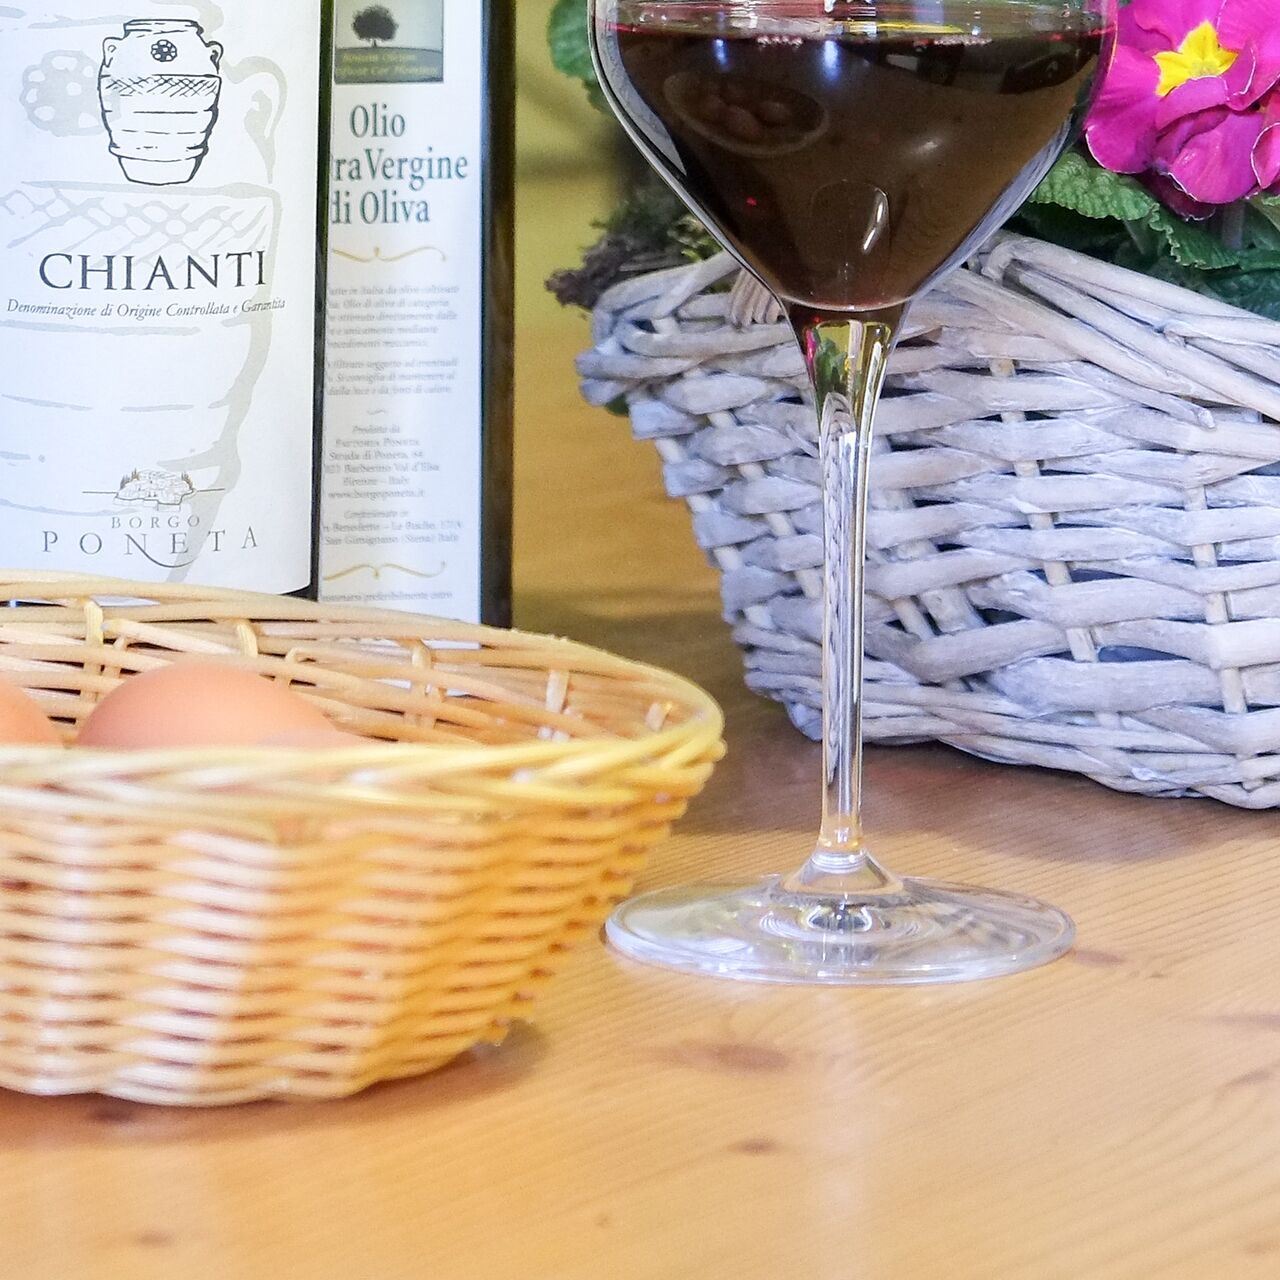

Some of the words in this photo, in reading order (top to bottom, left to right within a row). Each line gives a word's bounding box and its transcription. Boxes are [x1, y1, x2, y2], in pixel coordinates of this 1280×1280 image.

[350, 103, 406, 138] Olio
[364, 146, 468, 191] Vergine
[360, 190, 430, 225] Oliva
[39, 250, 266, 291] CHIANTI
[7, 298, 97, 319] Denominazione
[100, 303, 114, 317] di
[117, 303, 162, 320] Origine
[166, 301, 230, 317] Controllata
[233, 305, 238, 314] e
[242, 297, 285, 313] Garantita
[112, 513, 200, 529] BORGO
[42, 526, 259, 568] PONETA
